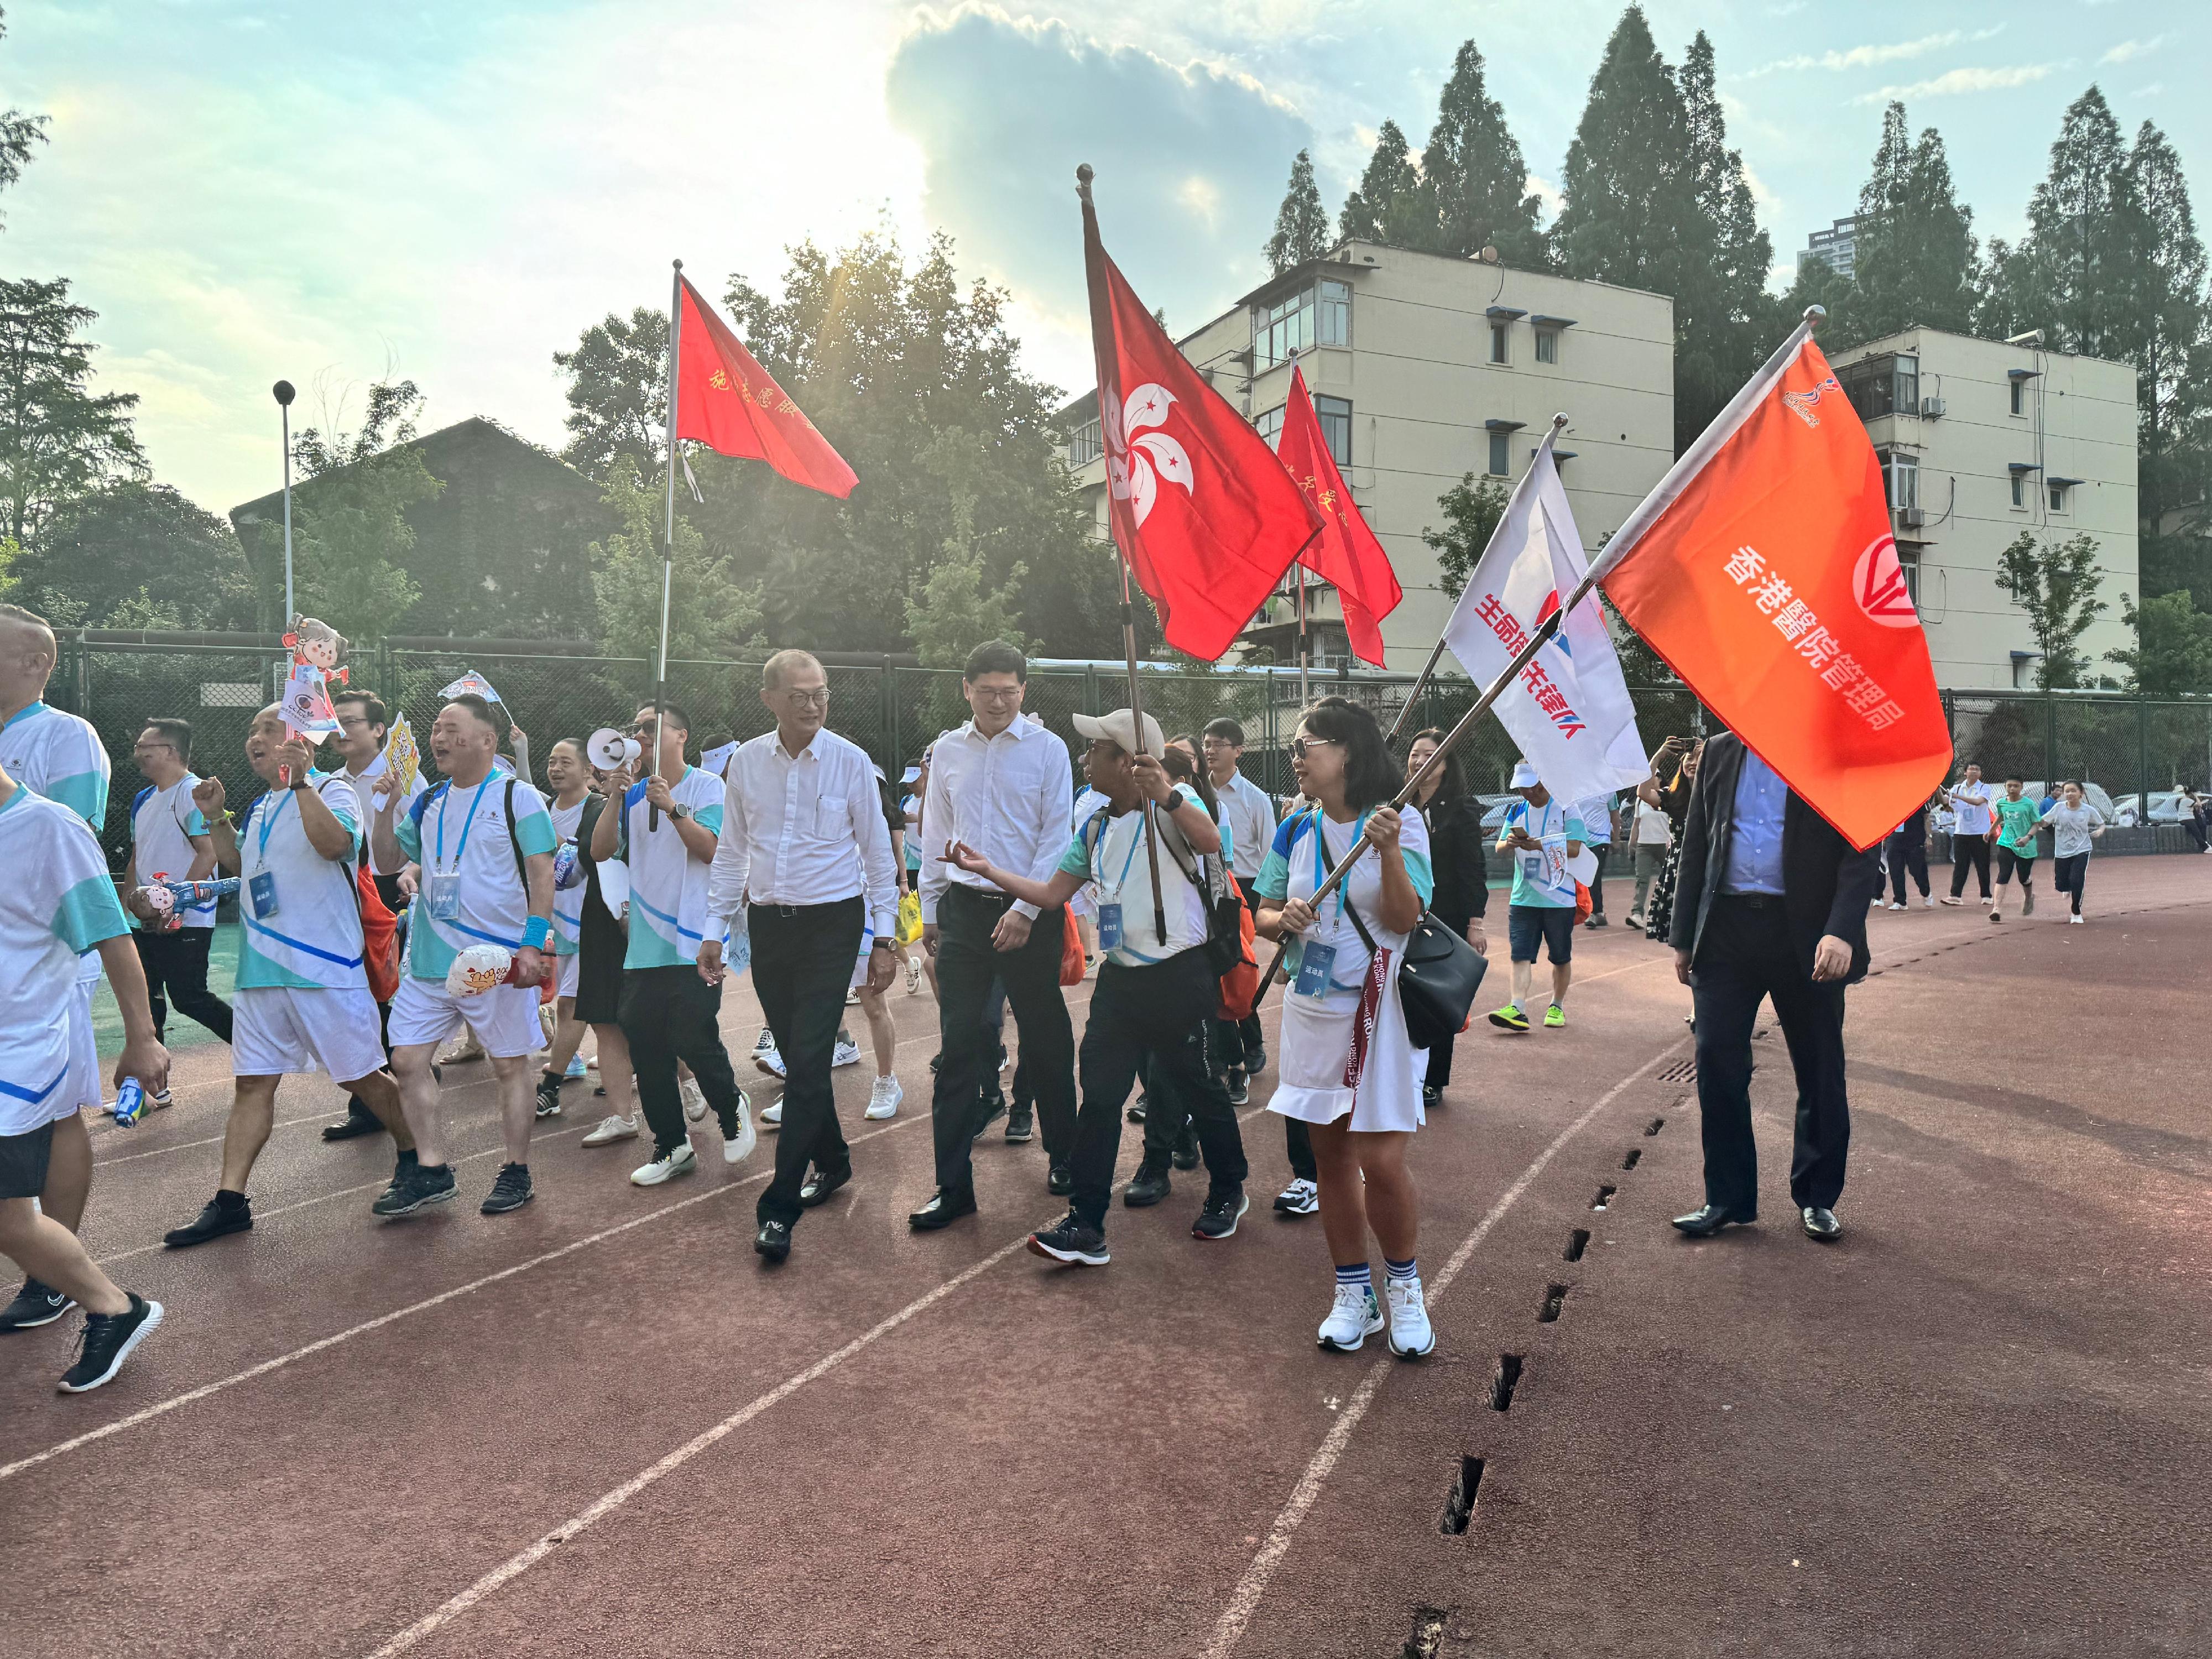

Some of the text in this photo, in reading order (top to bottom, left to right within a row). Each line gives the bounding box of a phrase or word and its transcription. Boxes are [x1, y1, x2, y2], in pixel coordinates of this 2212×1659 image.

[1723, 545, 1906, 732] 香港醫院管理局
